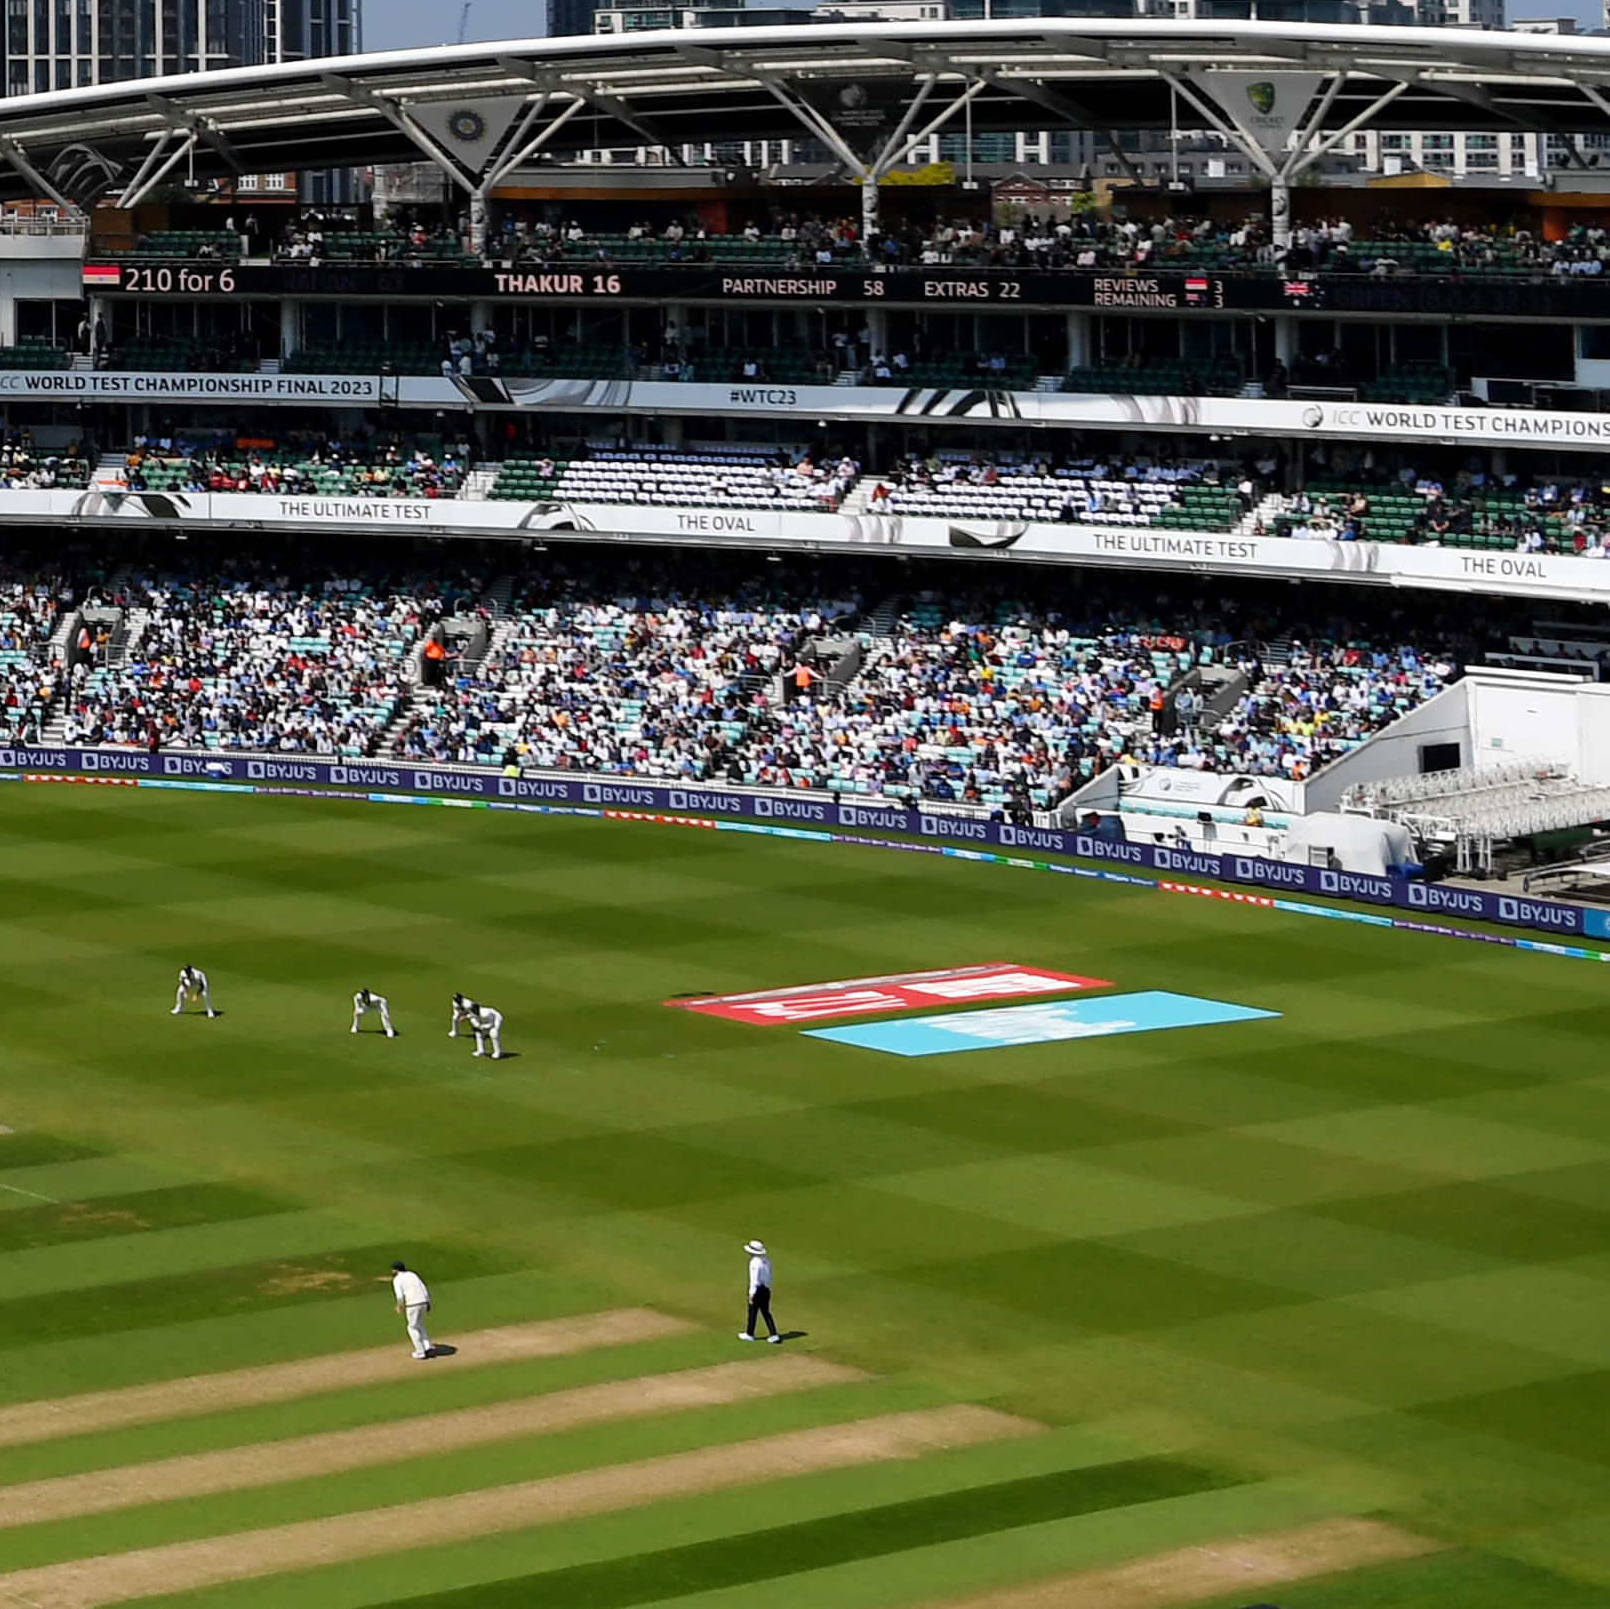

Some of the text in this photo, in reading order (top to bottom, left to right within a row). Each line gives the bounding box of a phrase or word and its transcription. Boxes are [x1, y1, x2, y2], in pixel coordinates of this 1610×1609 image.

[125, 268, 235, 291] 210 for 6
[494, 274, 621, 293] THAKUR 16
[723, 278, 884, 296] PARTNERSHIP 58
[924, 281, 1020, 298] EXTRAS 22
[1094, 278, 1223, 293] REVIEWS 3
[1094, 293, 1223, 307] REMAINING 3
[25, 376, 85, 391] WORLD
[92, 377, 129, 391] TEST
[135, 378, 272, 393] CHAMPIONSHIP
[277, 380, 327, 394] FINAL
[331, 381, 372, 395] 2023
[730, 390, 796, 405] #WTC23
[1333, 411, 1610, 437] ICC WORLD TEST CHAMPIONS
[280, 502, 431, 519] THE ULTIMATE TEST
[677, 515, 755, 531] THE OVAL
[1093, 534, 1257, 558] THE ULTIMATE TEST
[1461, 556, 1546, 578] THE OVAL
[17, 749, 66, 767] BYJU'S
[100, 753, 149, 771] BYJU'S
[266, 761, 316, 780] BYJU'S
[432, 770, 483, 791] BYJU'S
[517, 777, 568, 798] BYJU'S
[689, 791, 740, 811] BYJU'S
[857, 807, 907, 829] BYJU'S
[939, 816, 986, 838] BYJU'S
[1094, 839, 1141, 862] BYJU'S
[1254, 862, 1305, 884] BYJU'S
[1340, 874, 1392, 897] BYJU'S
[1519, 901, 1576, 926] BYJU'S
